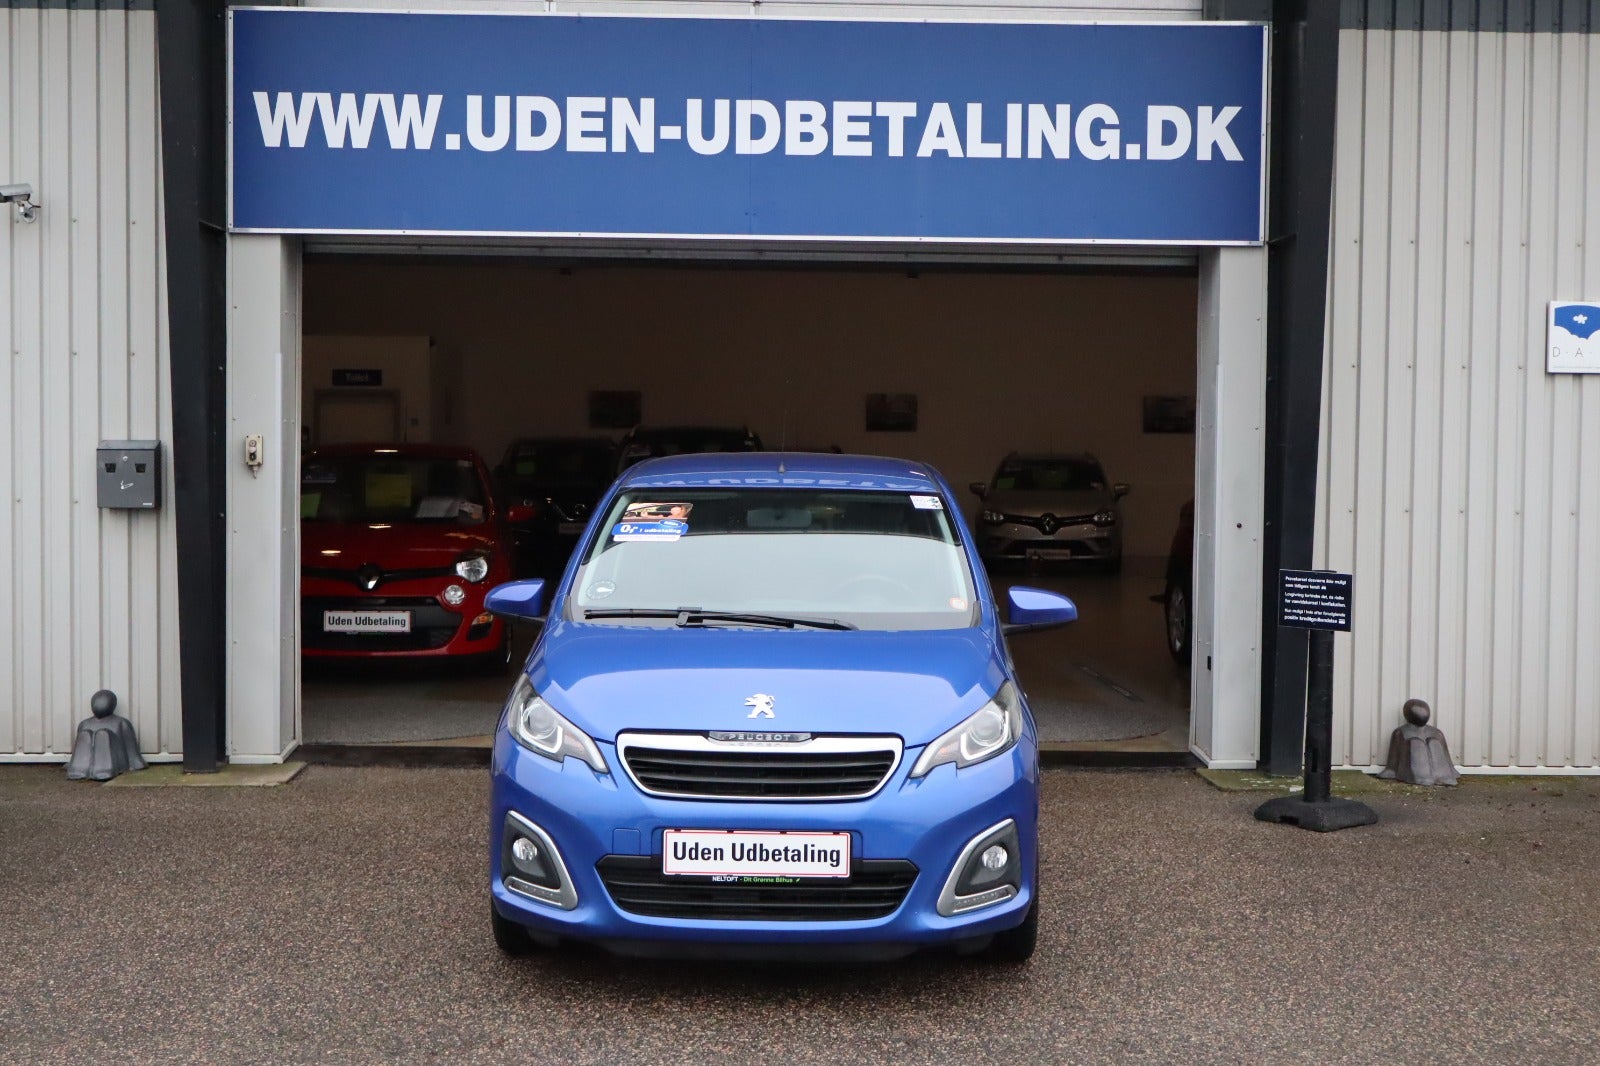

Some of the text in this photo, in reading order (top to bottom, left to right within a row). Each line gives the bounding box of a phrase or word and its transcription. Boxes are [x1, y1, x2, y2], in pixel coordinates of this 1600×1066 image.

[253, 92, 1243, 160] WWW.UDEN-UDBETALING.DK
[328, 616, 406, 627] Uden Udbetaling
[728, 733, 791, 741] PEUGEOT
[674, 842, 841, 867] Uden Udbetaling
